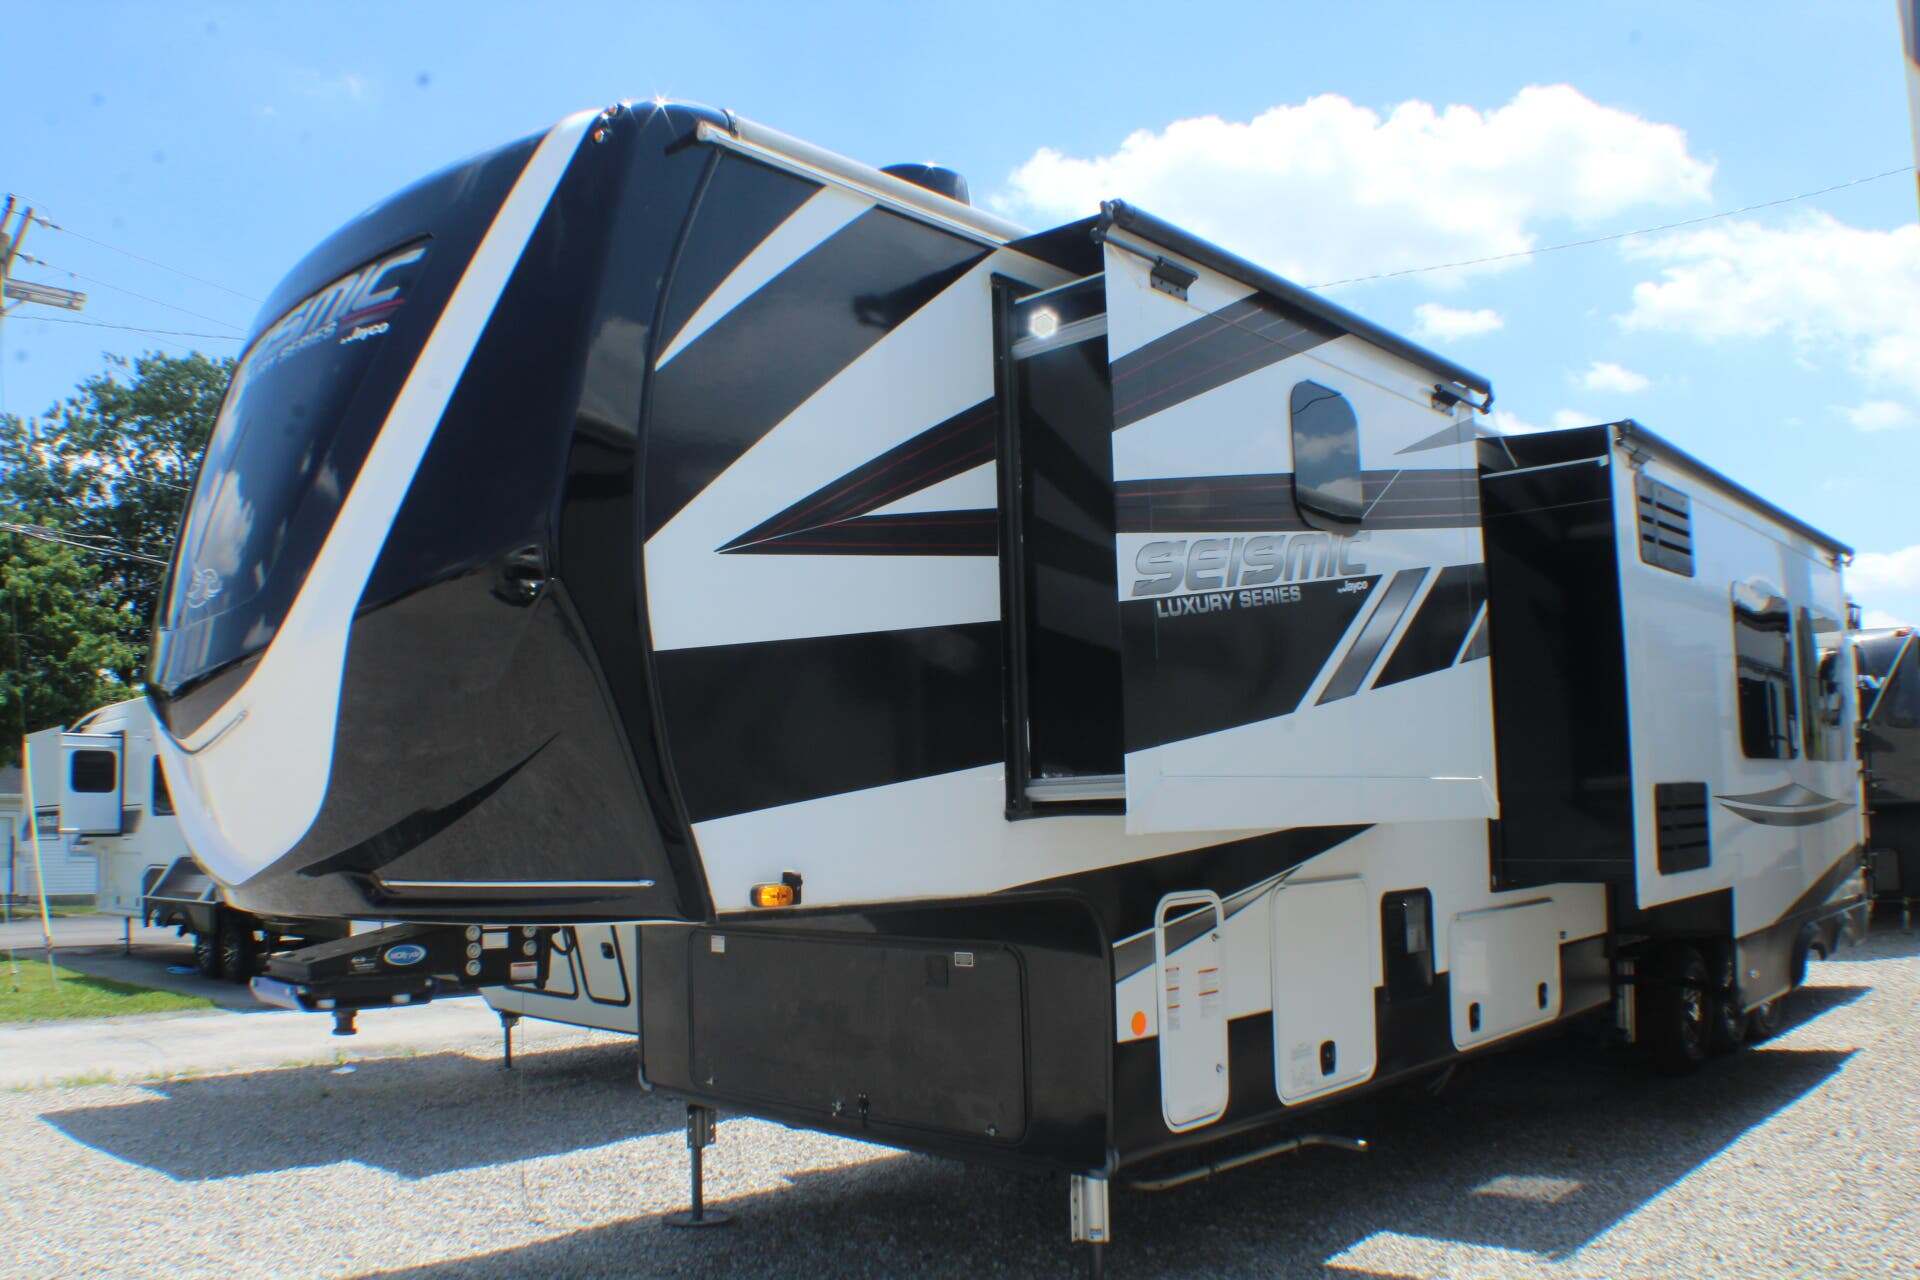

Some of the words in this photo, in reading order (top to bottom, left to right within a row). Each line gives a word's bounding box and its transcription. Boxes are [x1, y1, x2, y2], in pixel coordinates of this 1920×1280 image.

[1132, 533, 1371, 597] SEISMIC
[1156, 591, 1235, 619] LUXURY
[1239, 585, 1301, 609] SERIES
